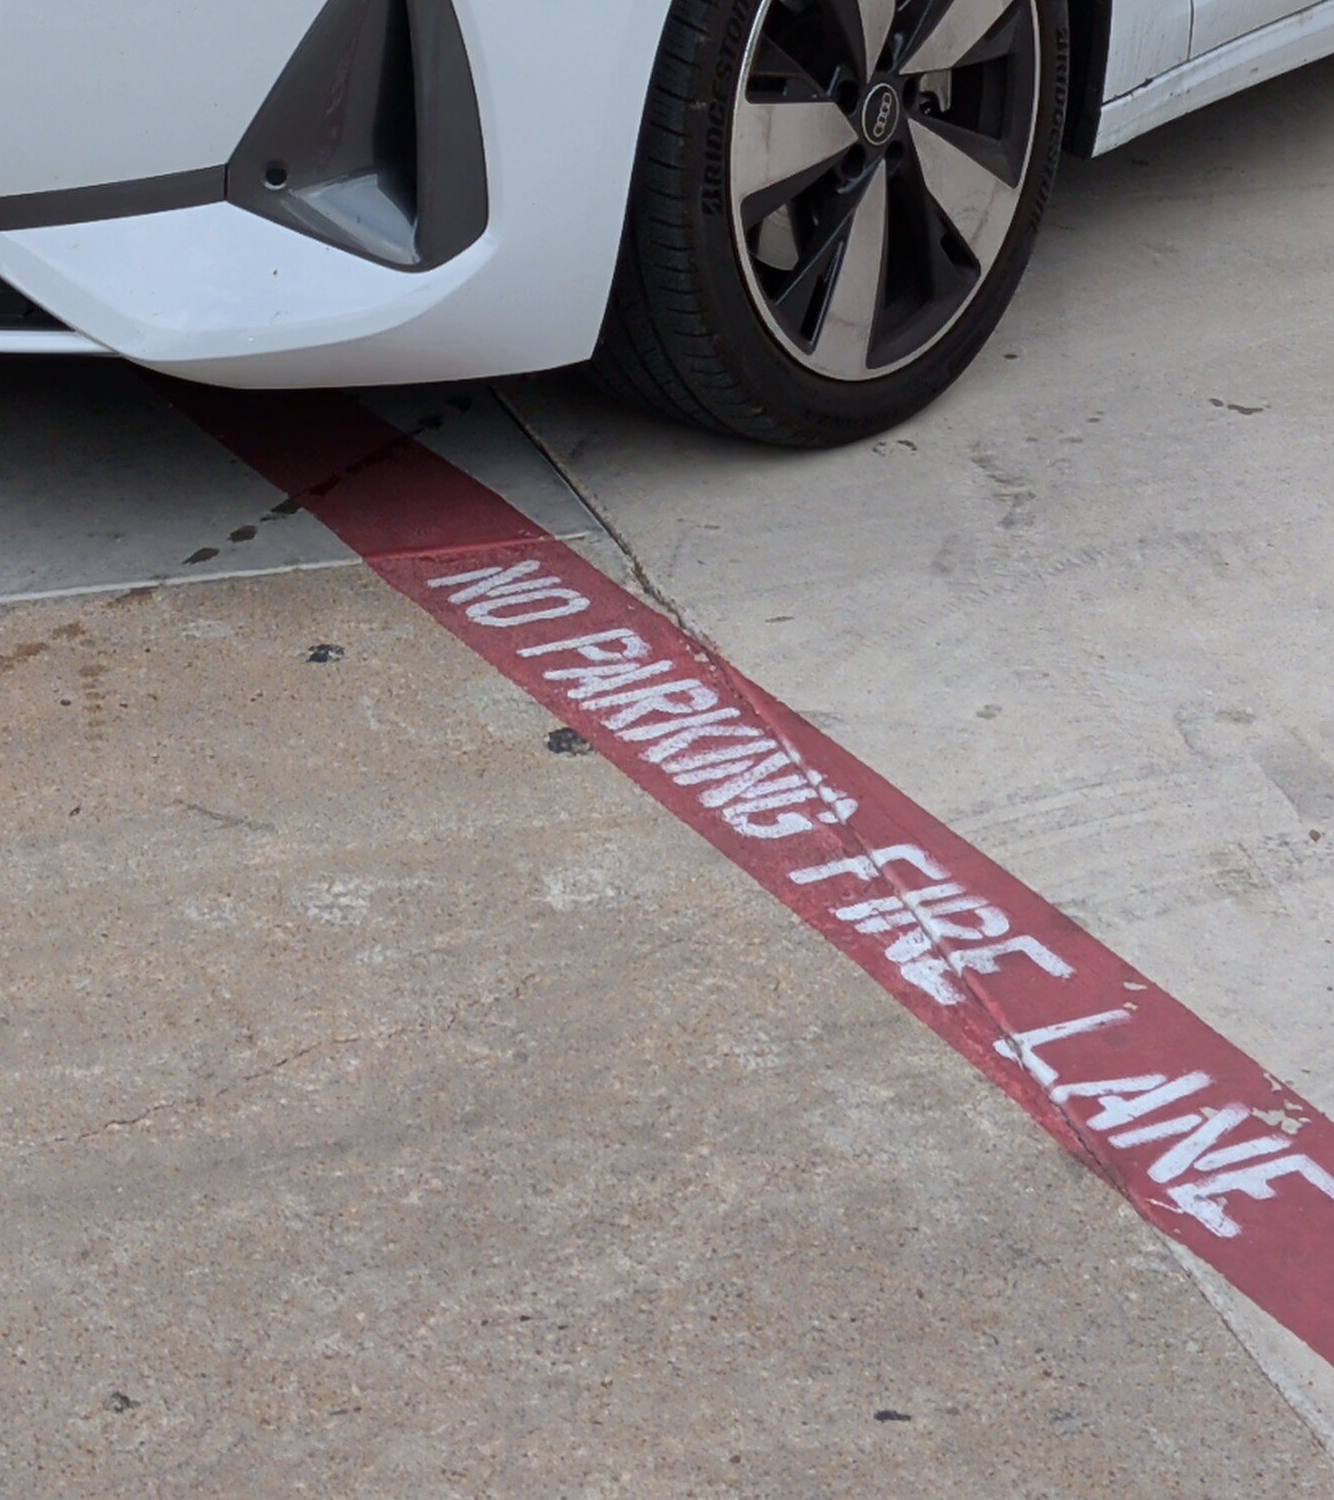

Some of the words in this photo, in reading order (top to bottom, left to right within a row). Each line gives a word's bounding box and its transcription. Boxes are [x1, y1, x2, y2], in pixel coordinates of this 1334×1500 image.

[426, 559, 591, 628] NO
[516, 628, 859, 840] PARKING
[787, 843, 1076, 1006] FIRE
